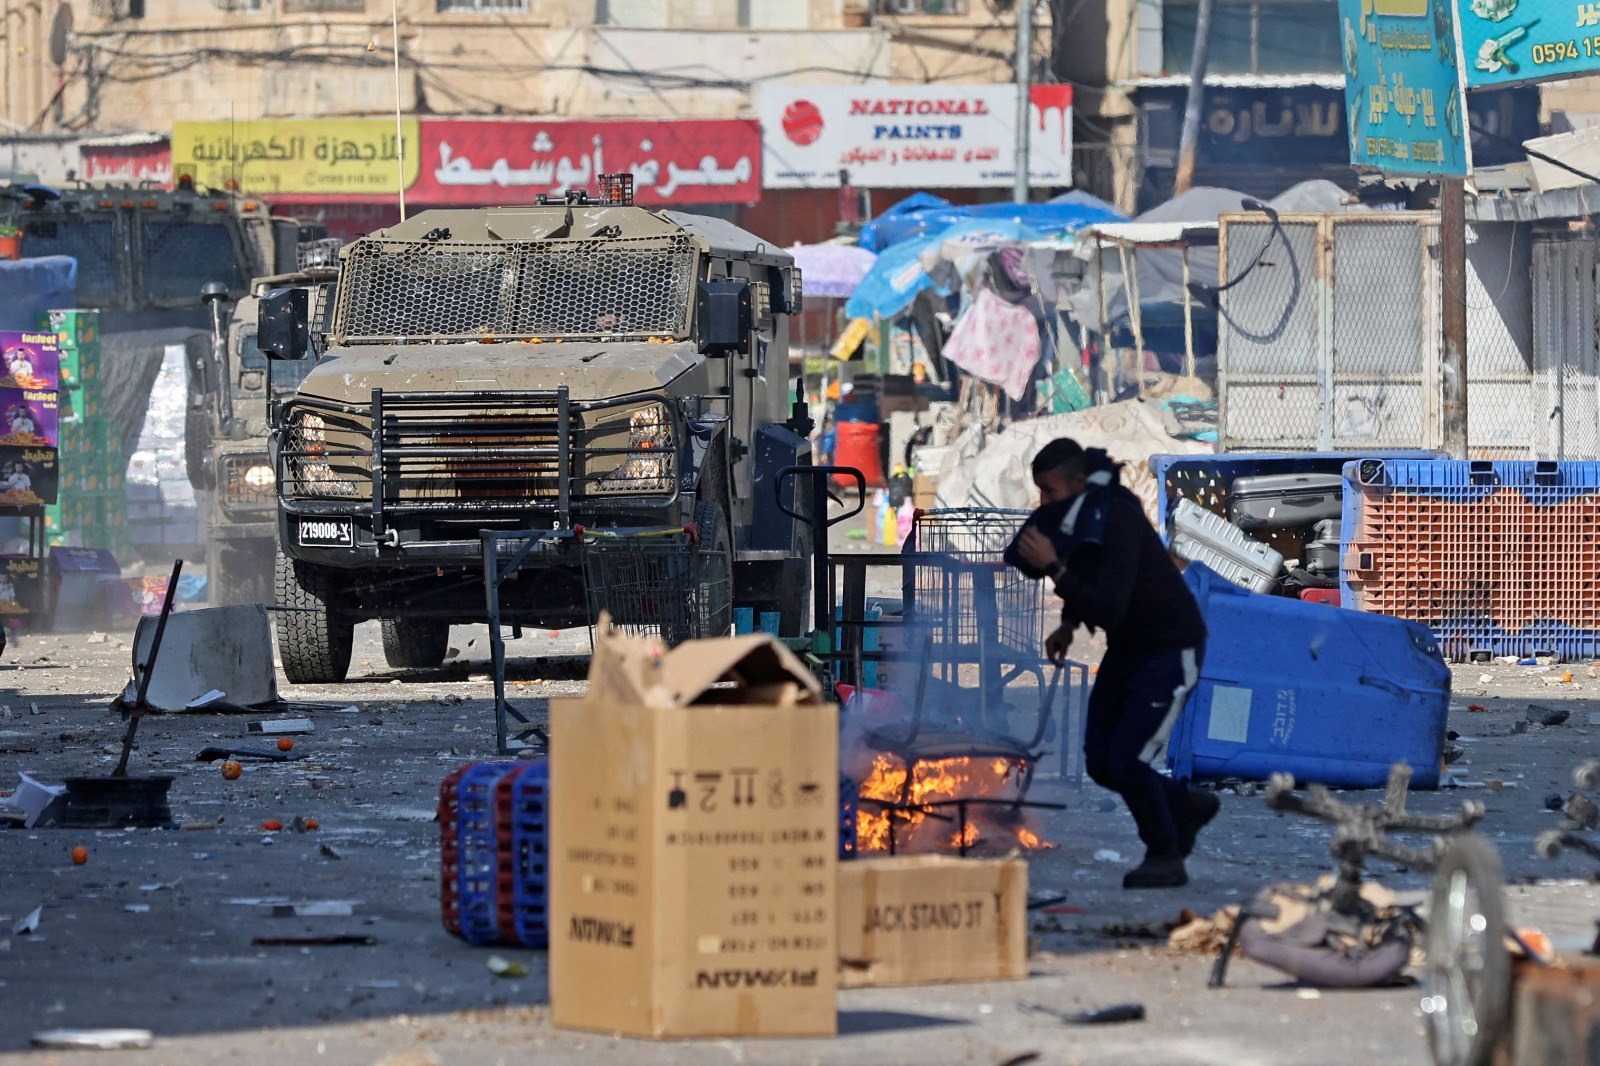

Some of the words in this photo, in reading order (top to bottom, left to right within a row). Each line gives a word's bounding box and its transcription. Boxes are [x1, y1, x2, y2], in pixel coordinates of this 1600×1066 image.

[1532, 40, 1579, 65] 0594
[849, 98, 989, 115] NATIONAL
[873, 124, 963, 140] PAINTS
[192, 134, 305, 168] الكهربائية
[315, 134, 406, 167] للأجهزة
[630, 137, 751, 198] معرض
[910, 901, 962, 930] STAND
[694, 967, 818, 989] FIXMAN
